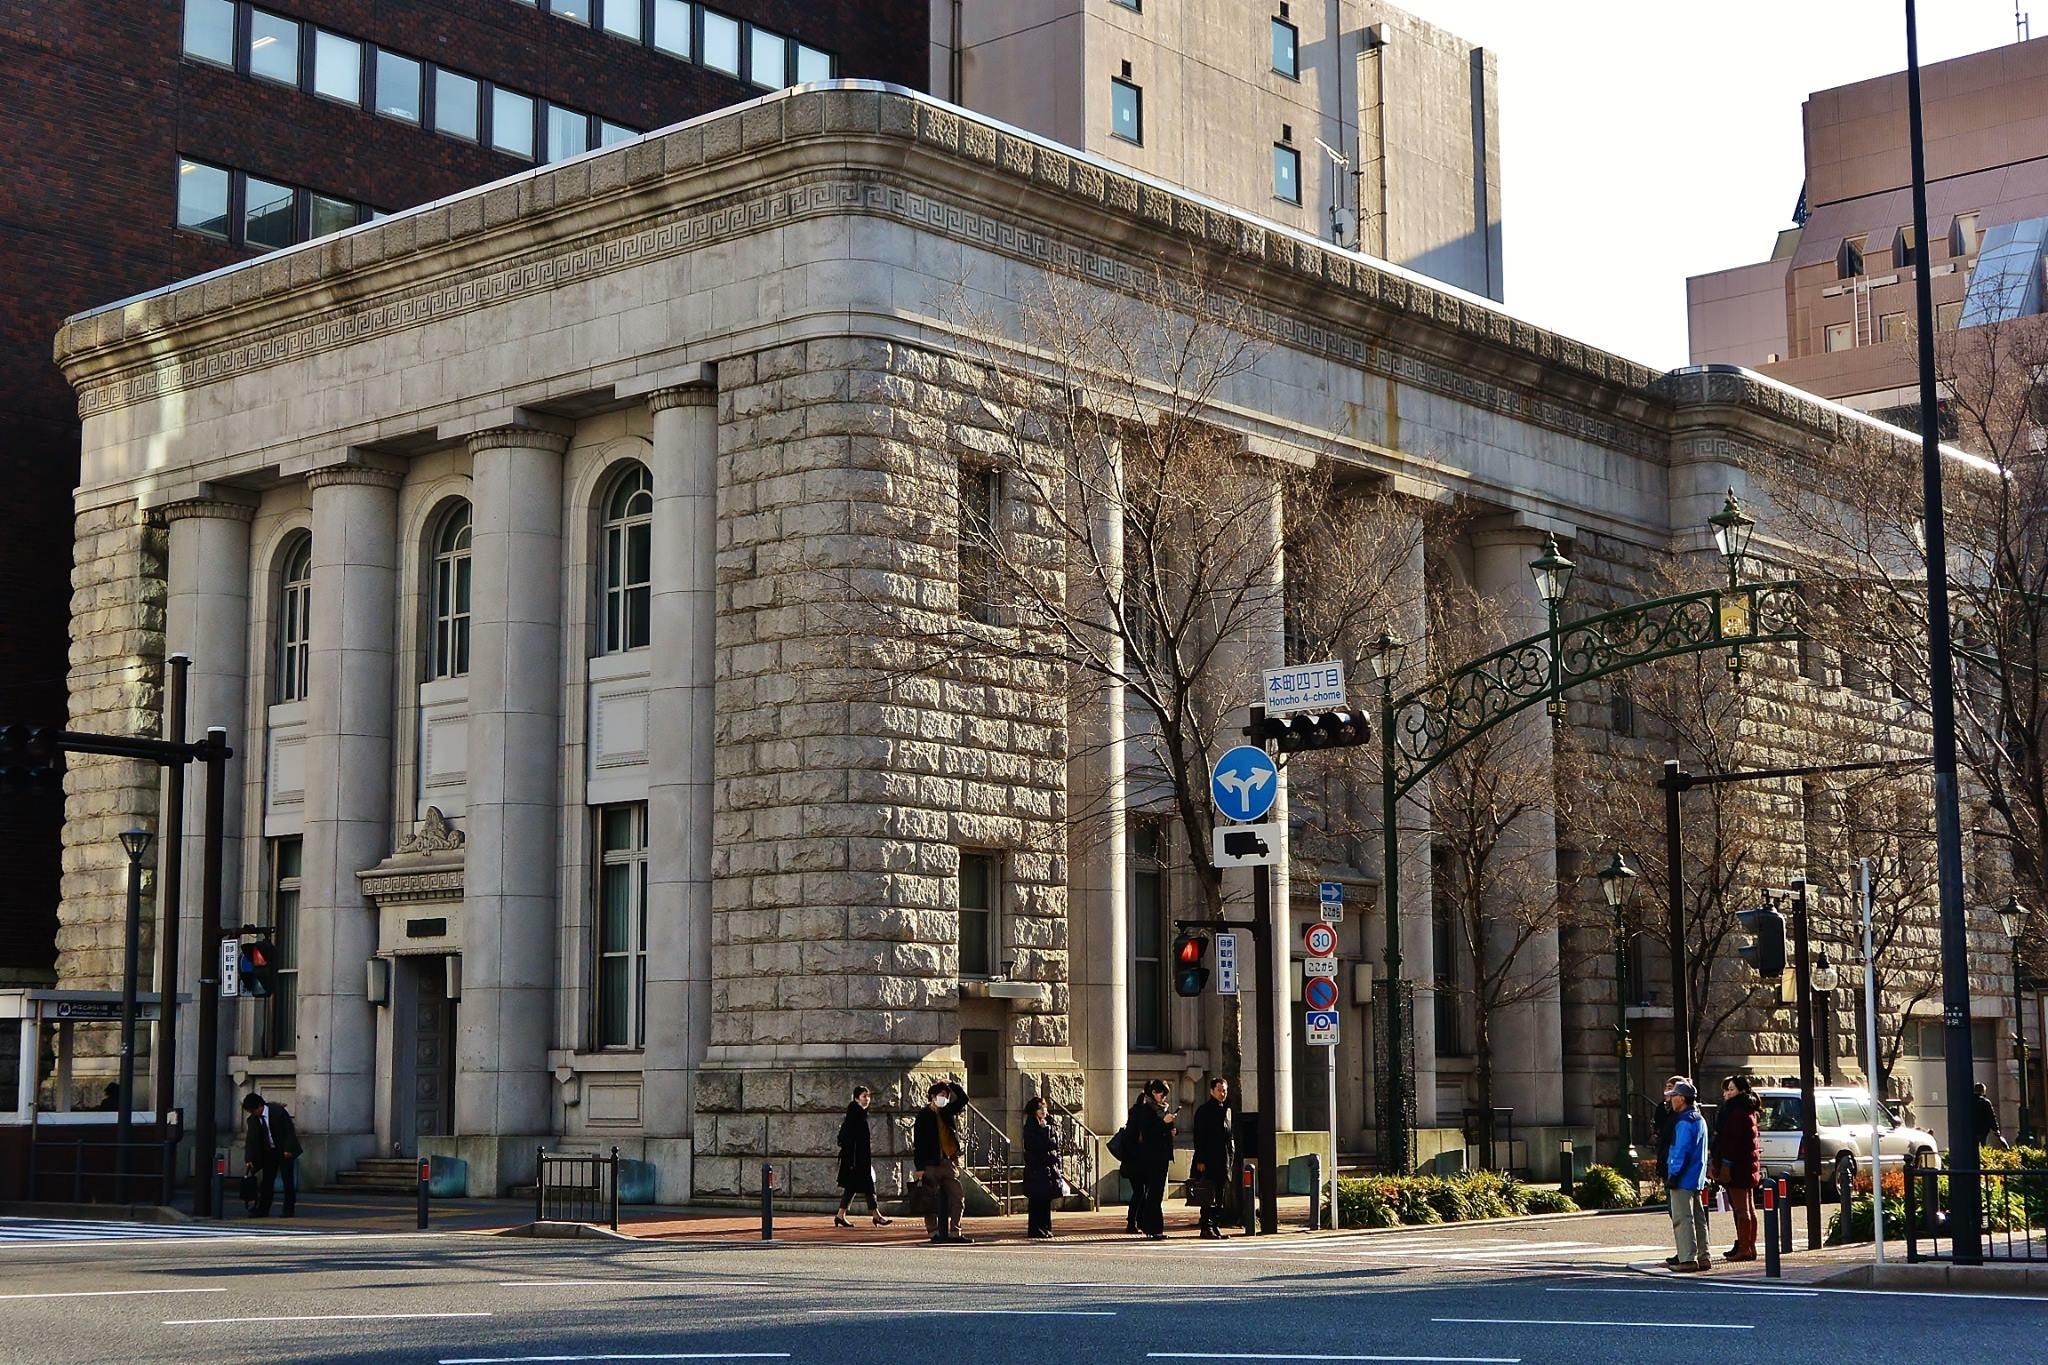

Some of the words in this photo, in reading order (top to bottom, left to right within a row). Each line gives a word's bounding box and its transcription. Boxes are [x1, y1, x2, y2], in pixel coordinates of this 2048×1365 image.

[1269, 669, 1339, 694] 本町四丁目
[1269, 695, 1300, 707] Honcho
[1303, 691, 1341, 702] 4-chome
[1323, 907, 1341, 918] ここから
[1312, 933, 1330, 948] 30
[1308, 961, 1334, 973] ここから
